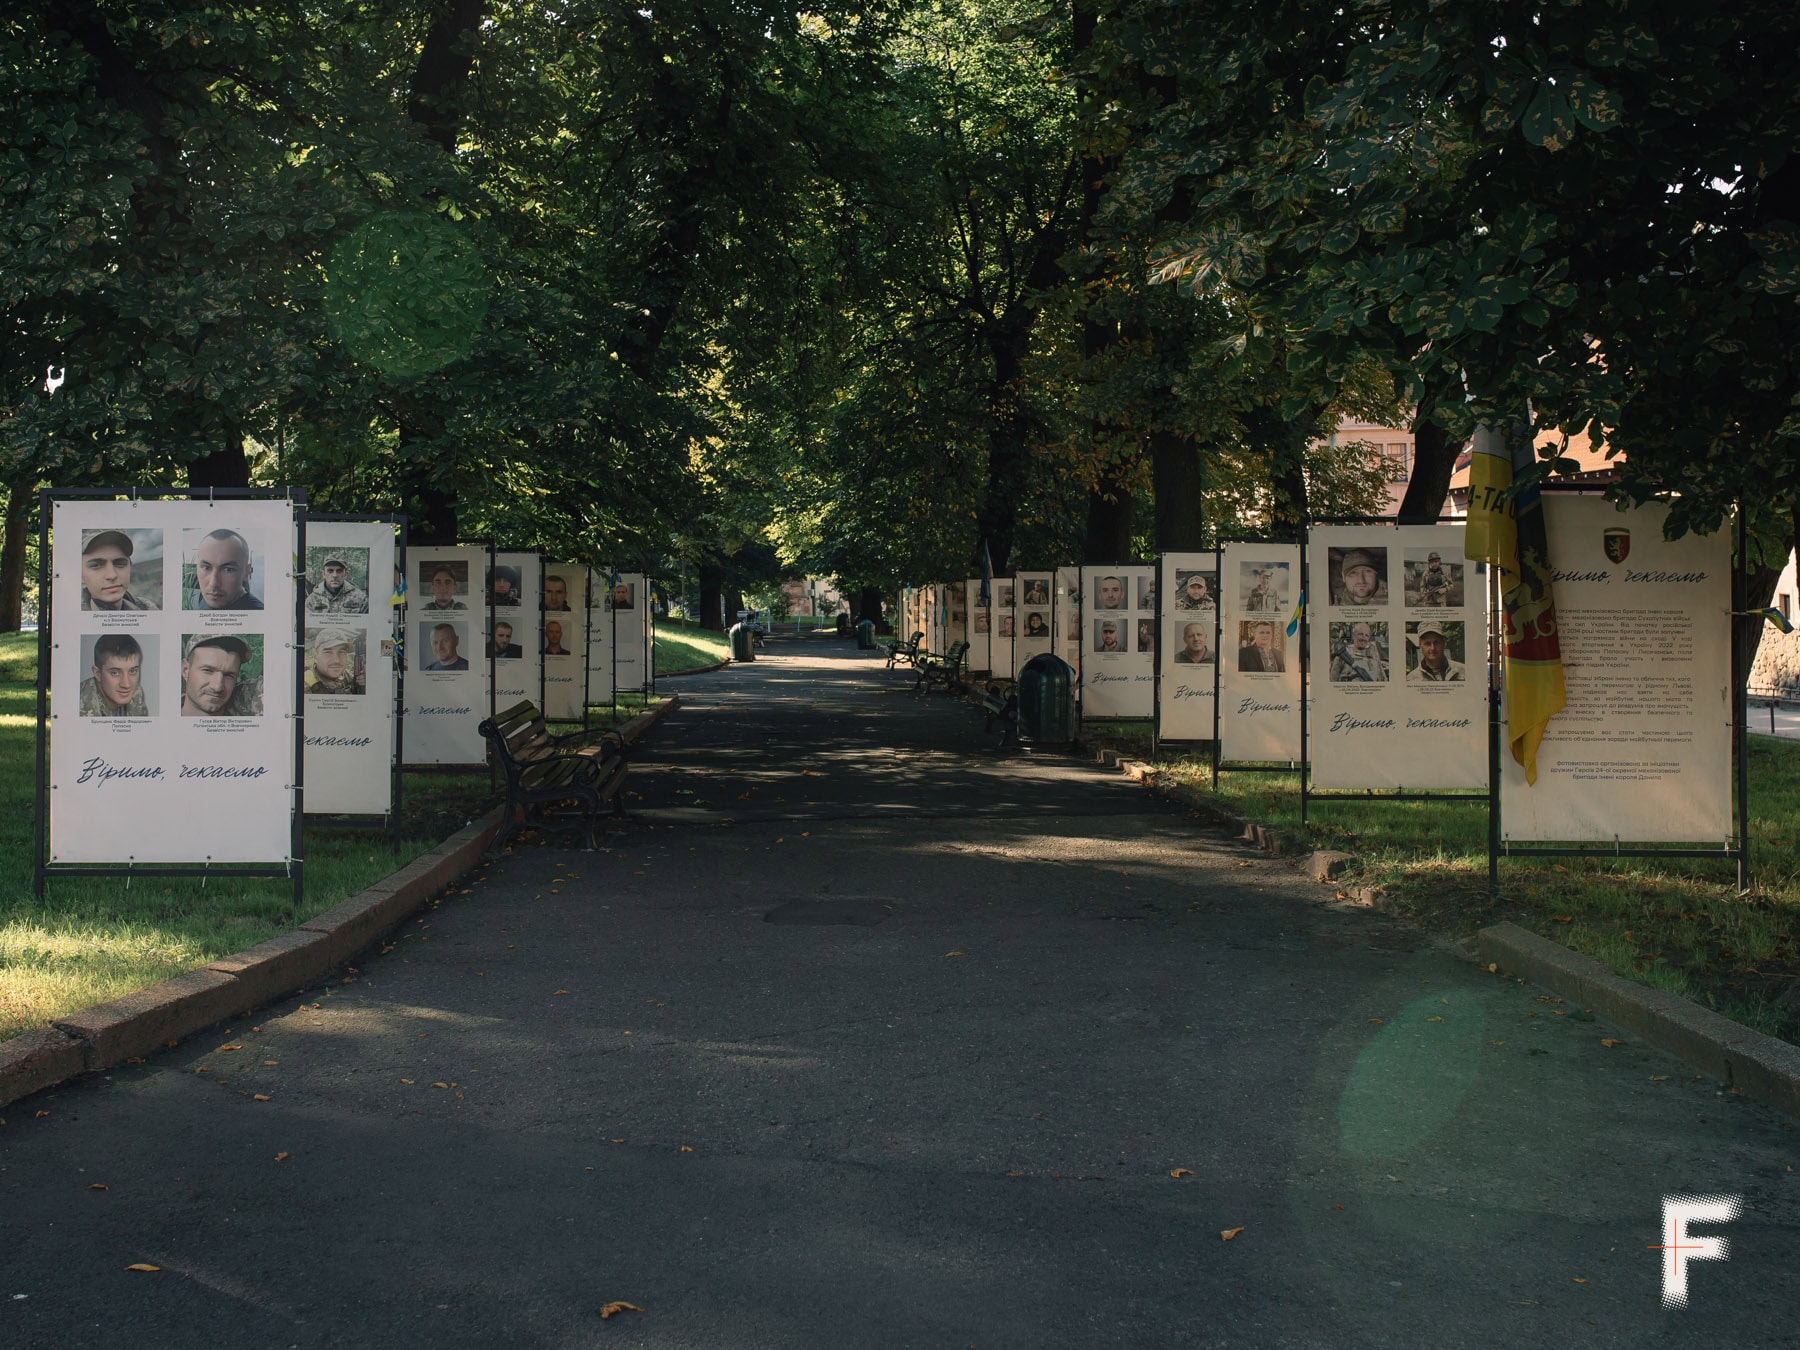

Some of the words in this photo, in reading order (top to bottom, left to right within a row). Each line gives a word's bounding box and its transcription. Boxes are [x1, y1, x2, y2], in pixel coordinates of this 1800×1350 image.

[1550, 568, 1610, 585] іримо,
[1624, 569, 1709, 583] чекаємо
[418, 705, 472, 715] чекаємо
[1237, 697, 1290, 718] Віримо,
[1330, 711, 1396, 736] Віримо,
[1405, 716, 1472, 729] чекаємо
[77, 757, 165, 788] Віримо,
[178, 764, 269, 778] чекаємо
